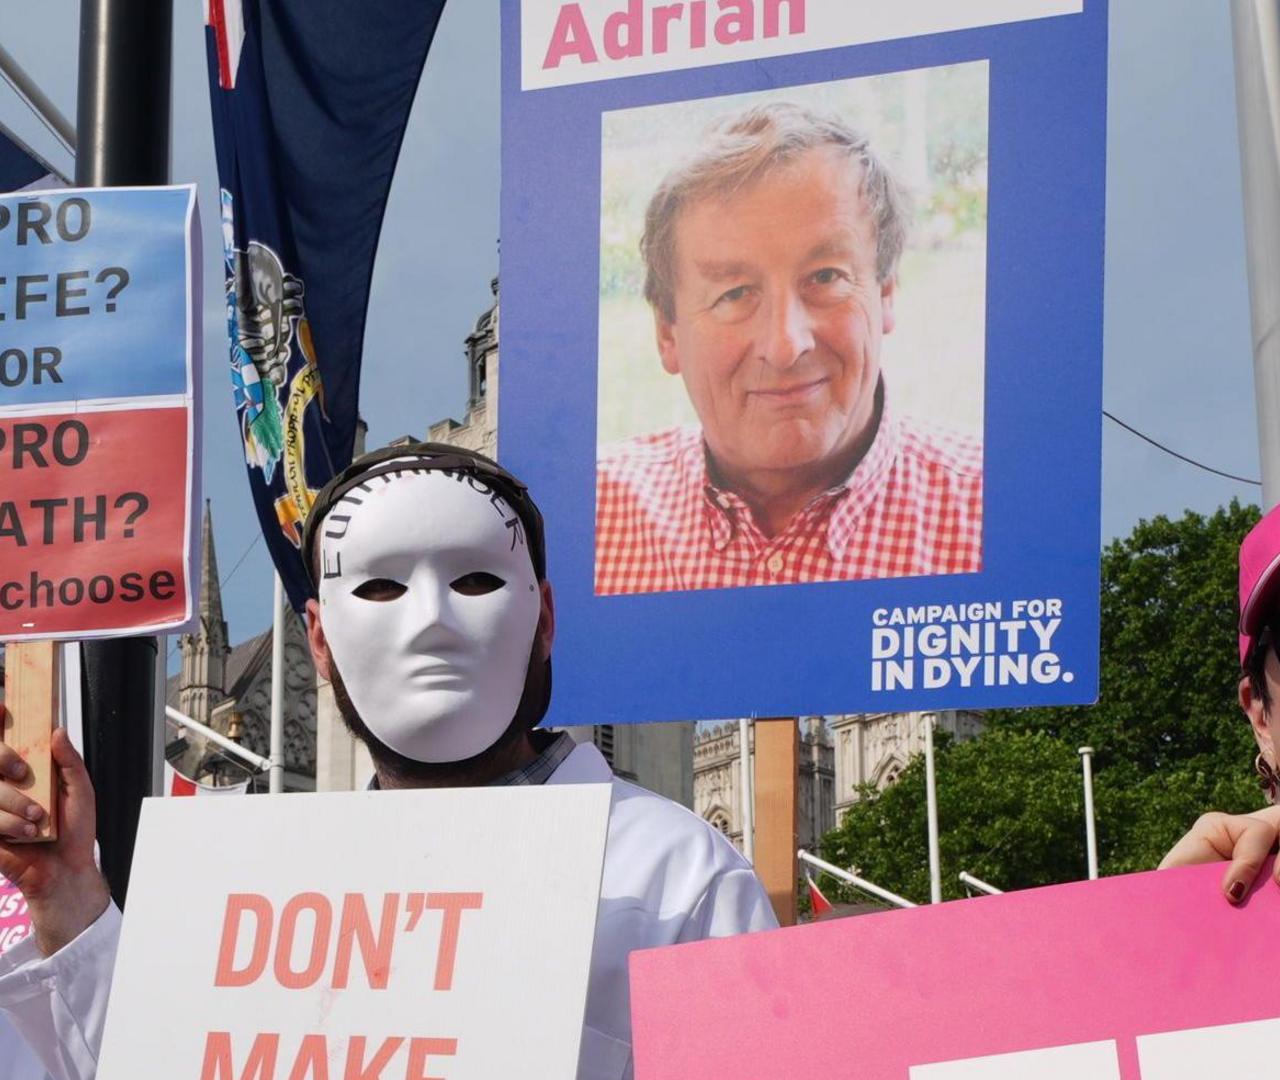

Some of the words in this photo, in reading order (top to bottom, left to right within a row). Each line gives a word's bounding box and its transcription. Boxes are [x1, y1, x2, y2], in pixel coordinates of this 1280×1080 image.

[541, 0, 807, 69] Adrian
[0, 569, 175, 610] choose
[872, 602, 1001, 626] CAMPAIGN
[1012, 598, 1062, 618] FOR
[872, 618, 1062, 659] DIGNITY
[871, 659, 914, 691] IN
[923, 652, 1074, 689] DYING.
[214, 891, 482, 991] DON'T
